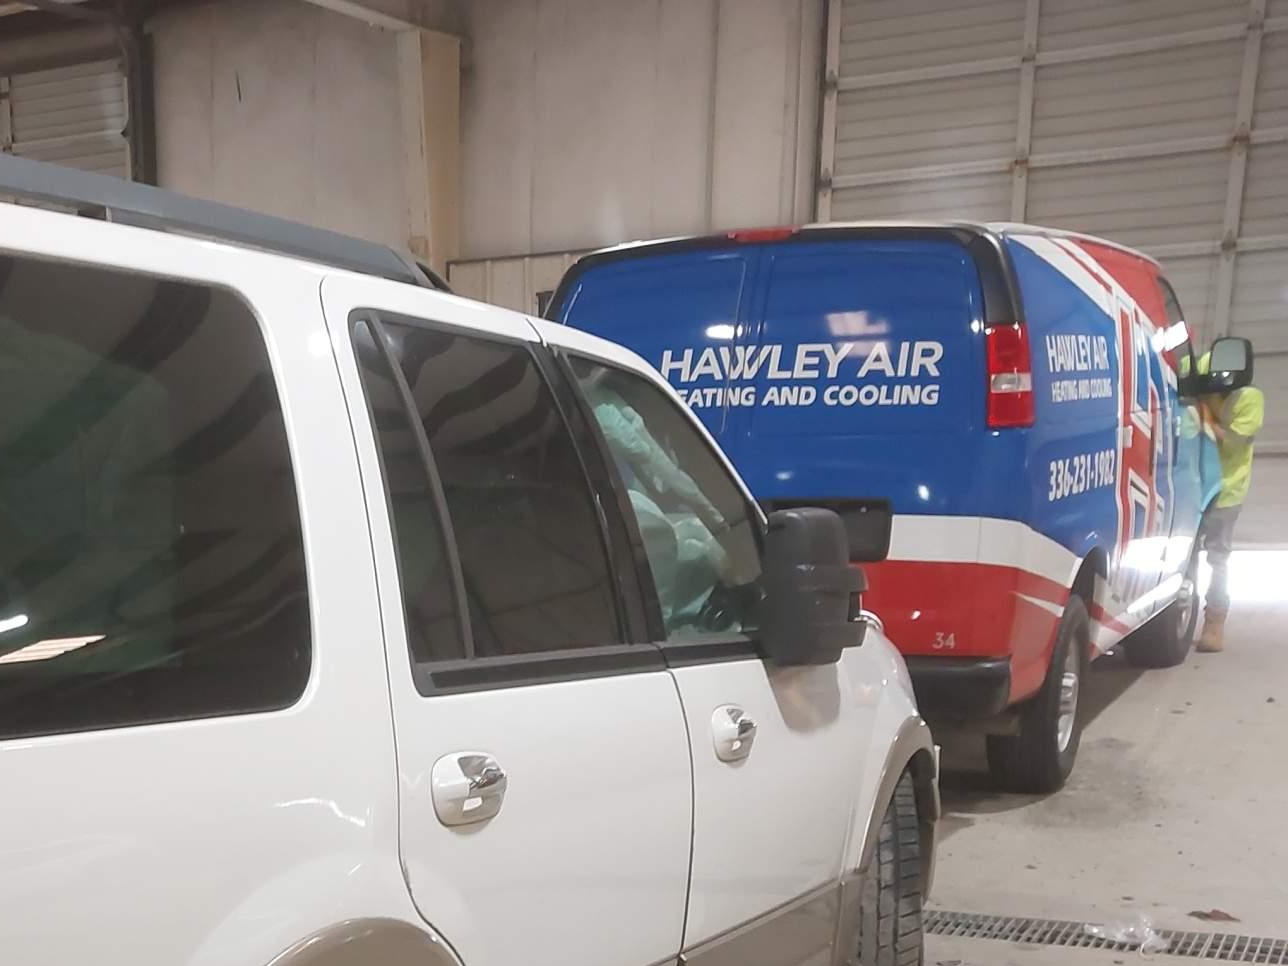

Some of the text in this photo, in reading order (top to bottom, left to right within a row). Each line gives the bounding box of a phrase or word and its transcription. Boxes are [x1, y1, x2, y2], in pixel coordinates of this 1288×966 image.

[662, 341, 943, 382] HAWLEY AIR
[1046, 334, 1110, 373] HAWLEY AIR
[676, 384, 940, 408] EATING AND COOLING
[1048, 449, 1115, 501] 336-231-1982
[932, 631, 956, 649] 34
